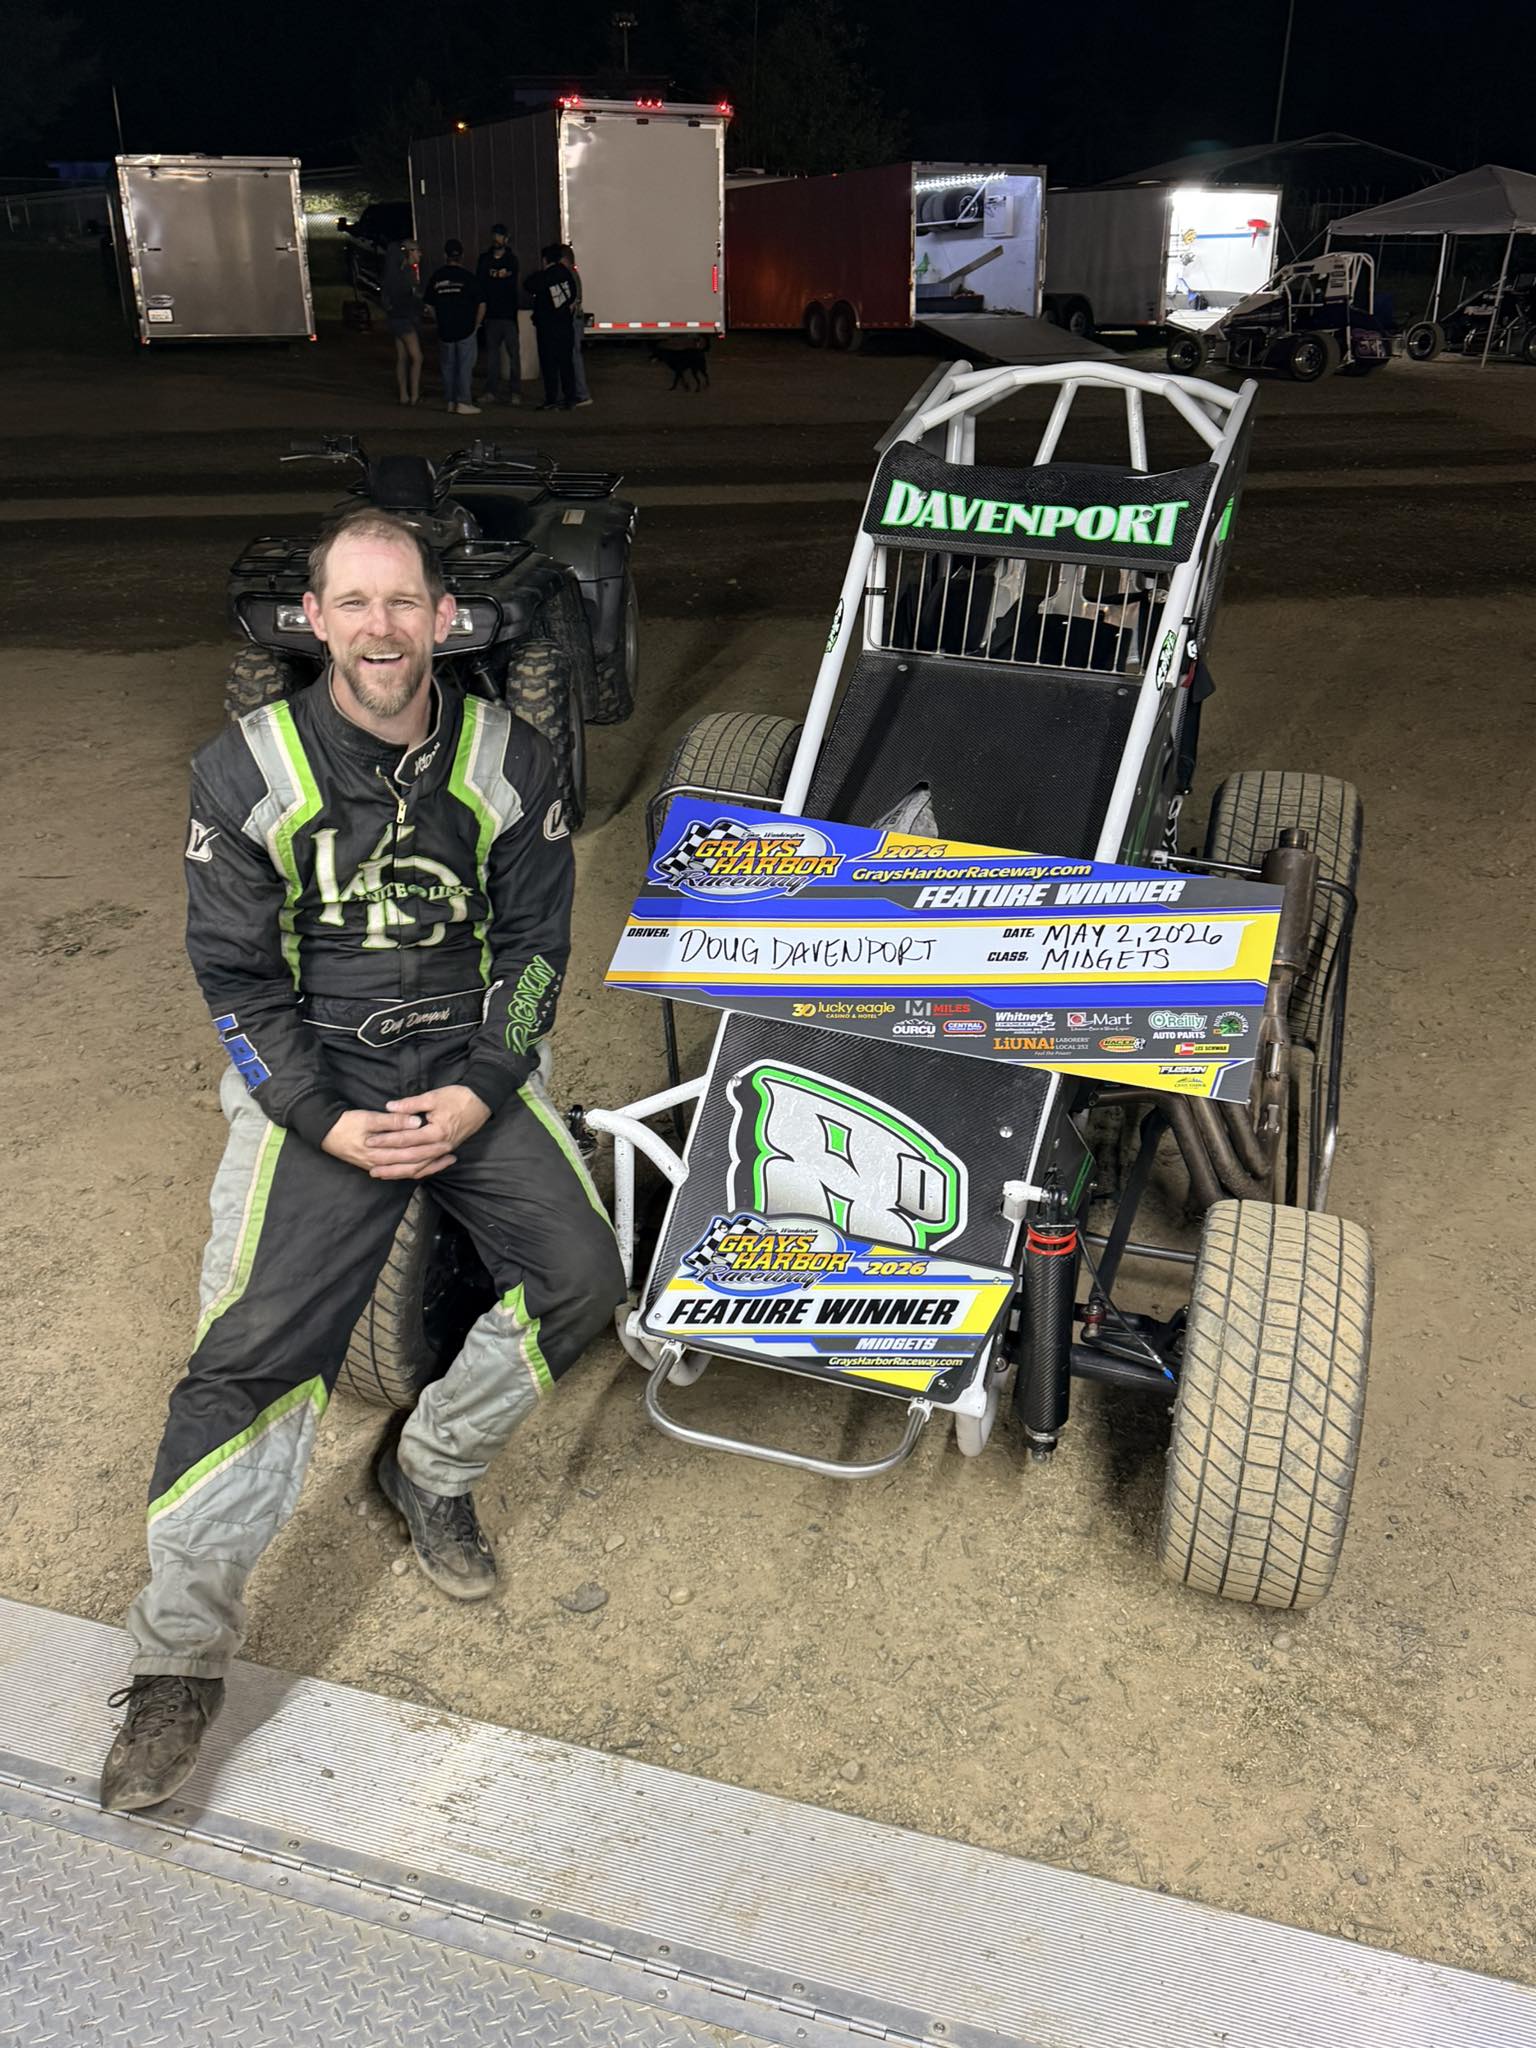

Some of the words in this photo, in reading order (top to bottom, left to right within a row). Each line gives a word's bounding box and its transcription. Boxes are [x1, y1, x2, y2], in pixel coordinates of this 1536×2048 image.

[881, 479, 1190, 547] DAVENPORT
[695, 838, 804, 858] GRAYS
[886, 845, 945, 859] 2026
[710, 855, 841, 875] HARBOR
[852, 864, 1092, 882] GraysHarborRaceway.com
[675, 869, 809, 893] Raceway
[913, 883, 1050, 909] FEATURE
[1054, 880, 1187, 904] WINNER
[1041, 923, 1106, 949] MAY
[679, 928, 759, 963] DOUG
[771, 936, 938, 970] DAVENPORT
[1041, 948, 1170, 971] MIDGETS
[818, 1002, 854, 1013] lucky
[856, 1002, 895, 1016] eagle
[933, 1004, 970, 1013] MILES
[995, 1011, 1054, 1022] Whitney's
[1151, 1012, 1206, 1029] O'Reilly
[892, 1025, 936, 1035] OURCU
[1153, 1031, 1176, 1039] AUTO
[1177, 1031, 1206, 1039] PARTS
[992, 1037, 1055, 1050] LiUNA!
[1160, 1065, 1207, 1074] FUSION
[717, 1234, 816, 1253] GRAYS
[731, 1252, 852, 1272] HARBOR
[865, 1262, 927, 1276] 2026
[699, 1265, 822, 1289] Raceway
[667, 1299, 814, 1325] FEATURE
[814, 1299, 960, 1326] WINNER
[855, 1337, 939, 1351] MIDGETS
[828, 1356, 964, 1367] GraysHarborRaceway.com
